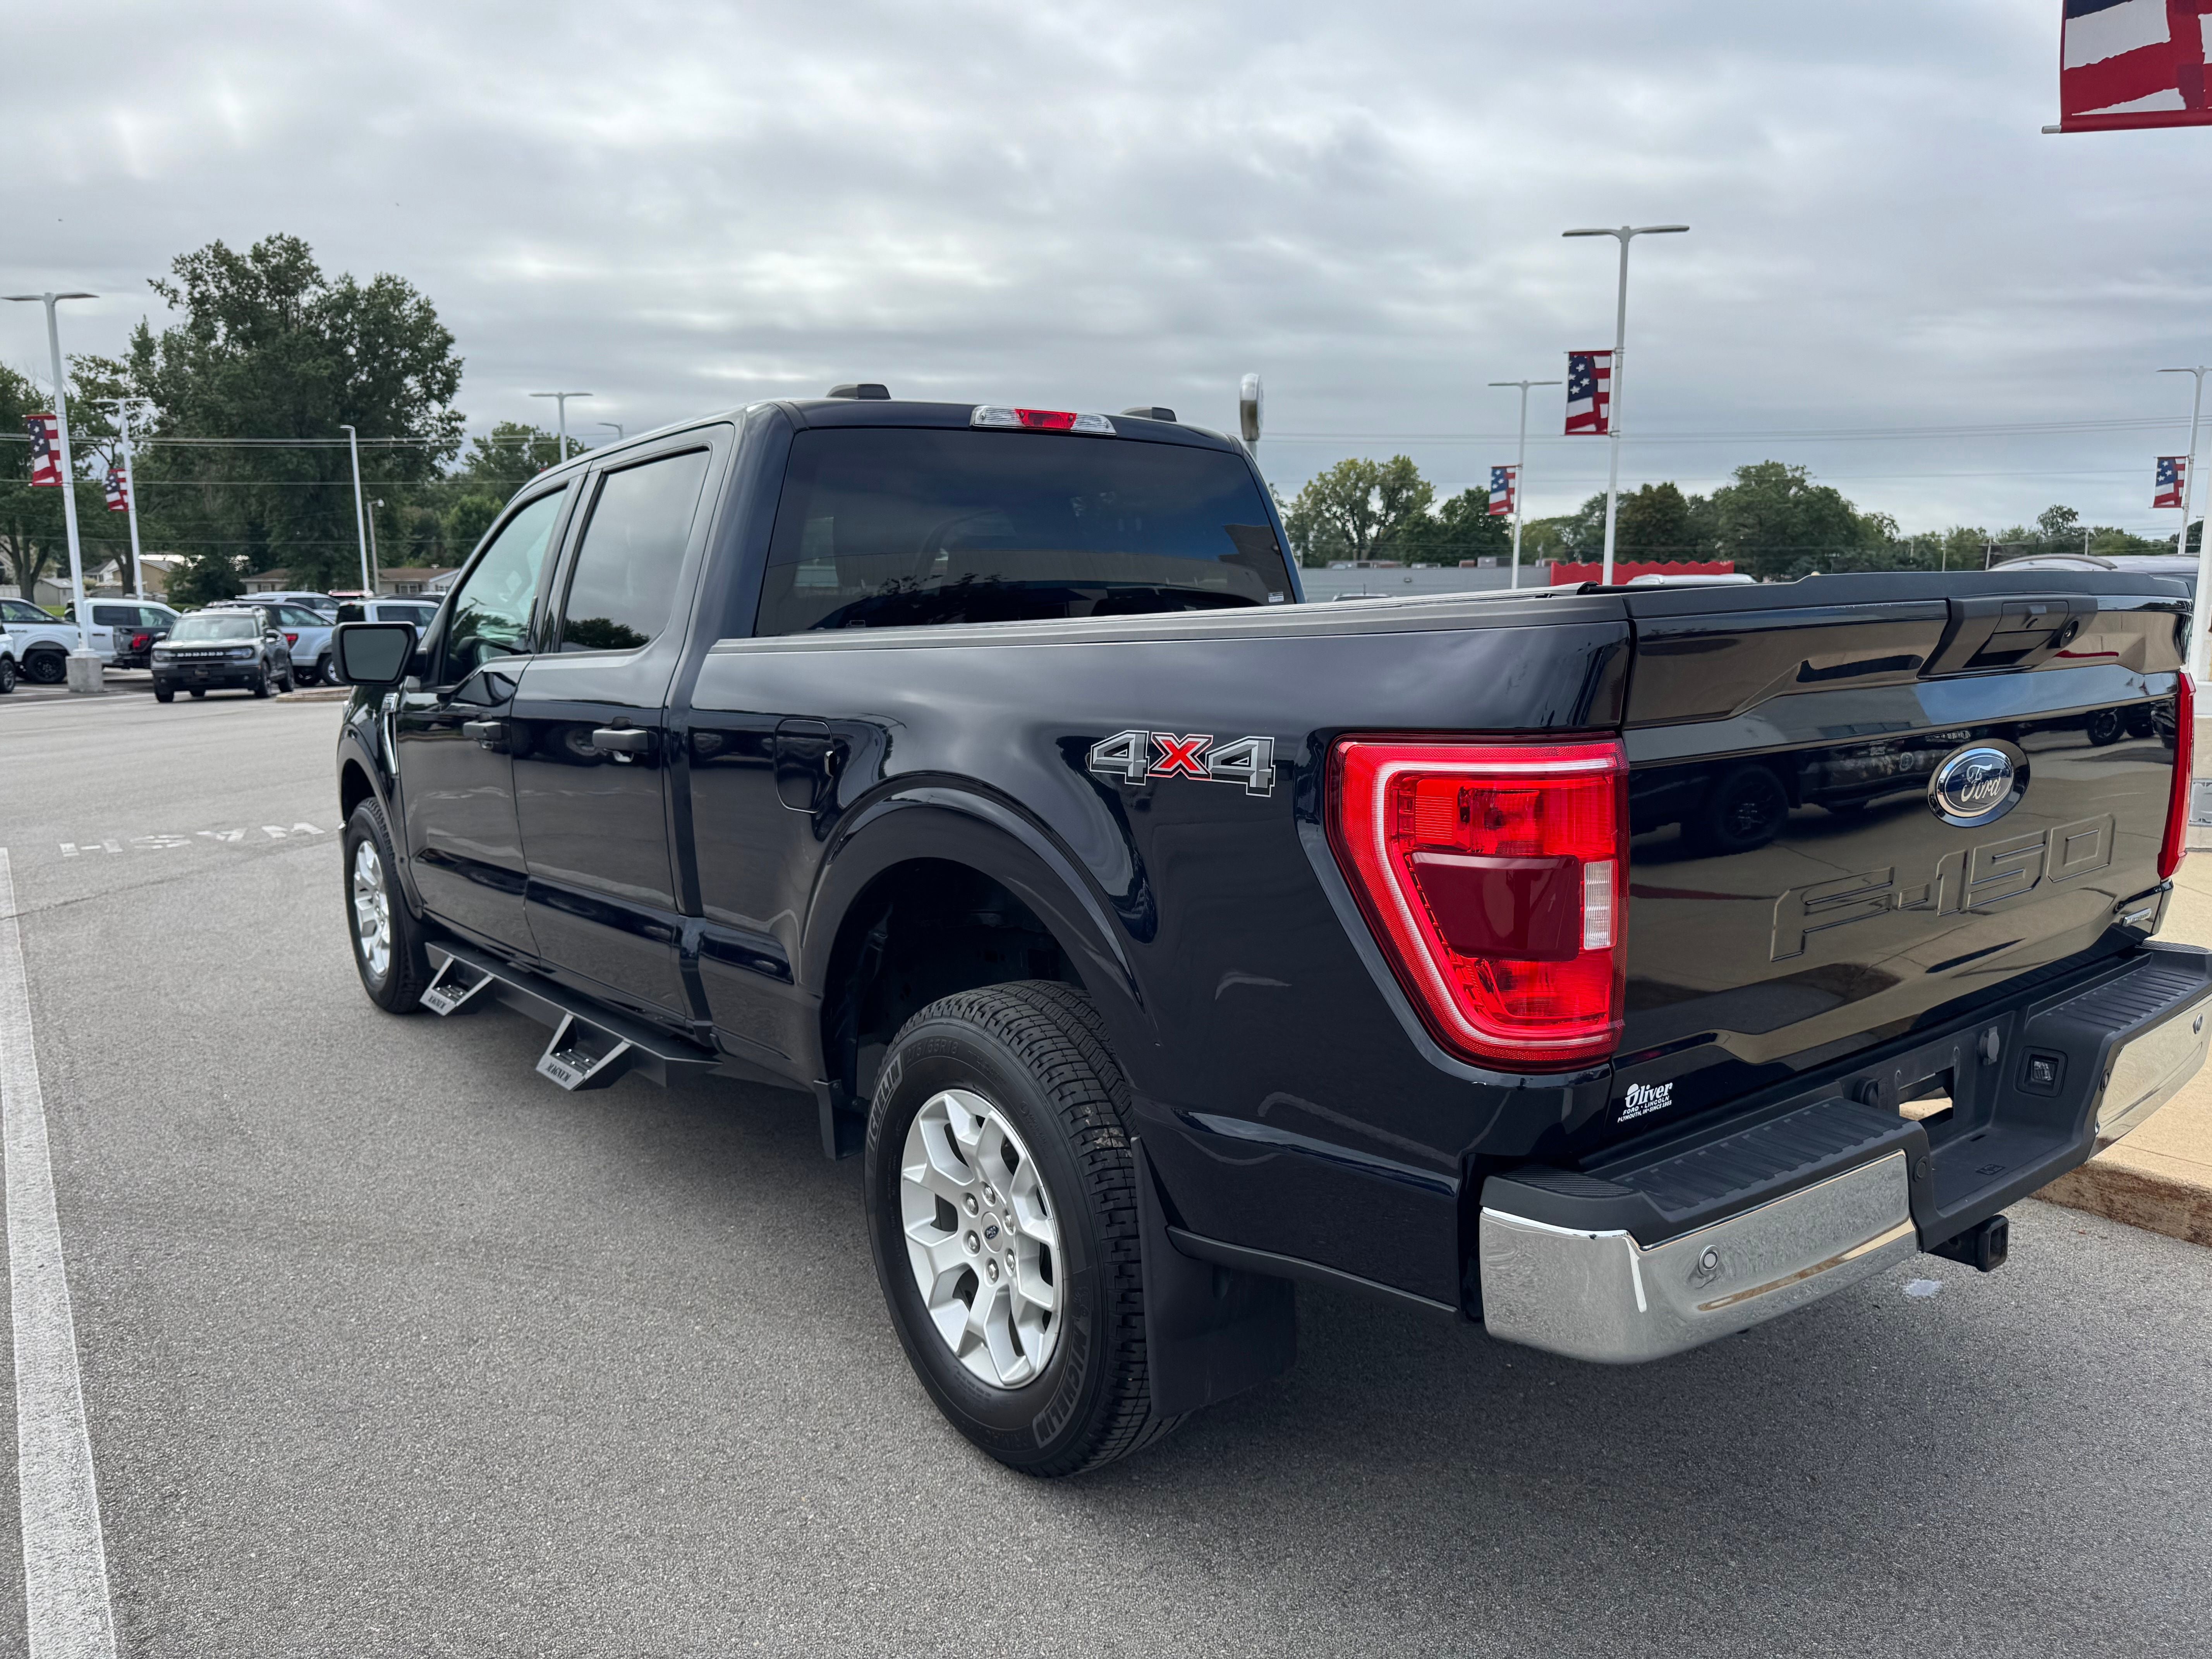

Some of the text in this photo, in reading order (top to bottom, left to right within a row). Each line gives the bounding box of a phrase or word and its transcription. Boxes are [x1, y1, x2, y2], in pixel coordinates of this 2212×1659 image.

[1960, 764, 2004, 802] Ford
[1770, 812, 2116, 962] F-150
[1623, 1095, 1669, 1115] FORD LINCOLN
[1625, 1082, 1673, 1108] Oliver
[1036, 1322, 1087, 1443] MICHELIN
